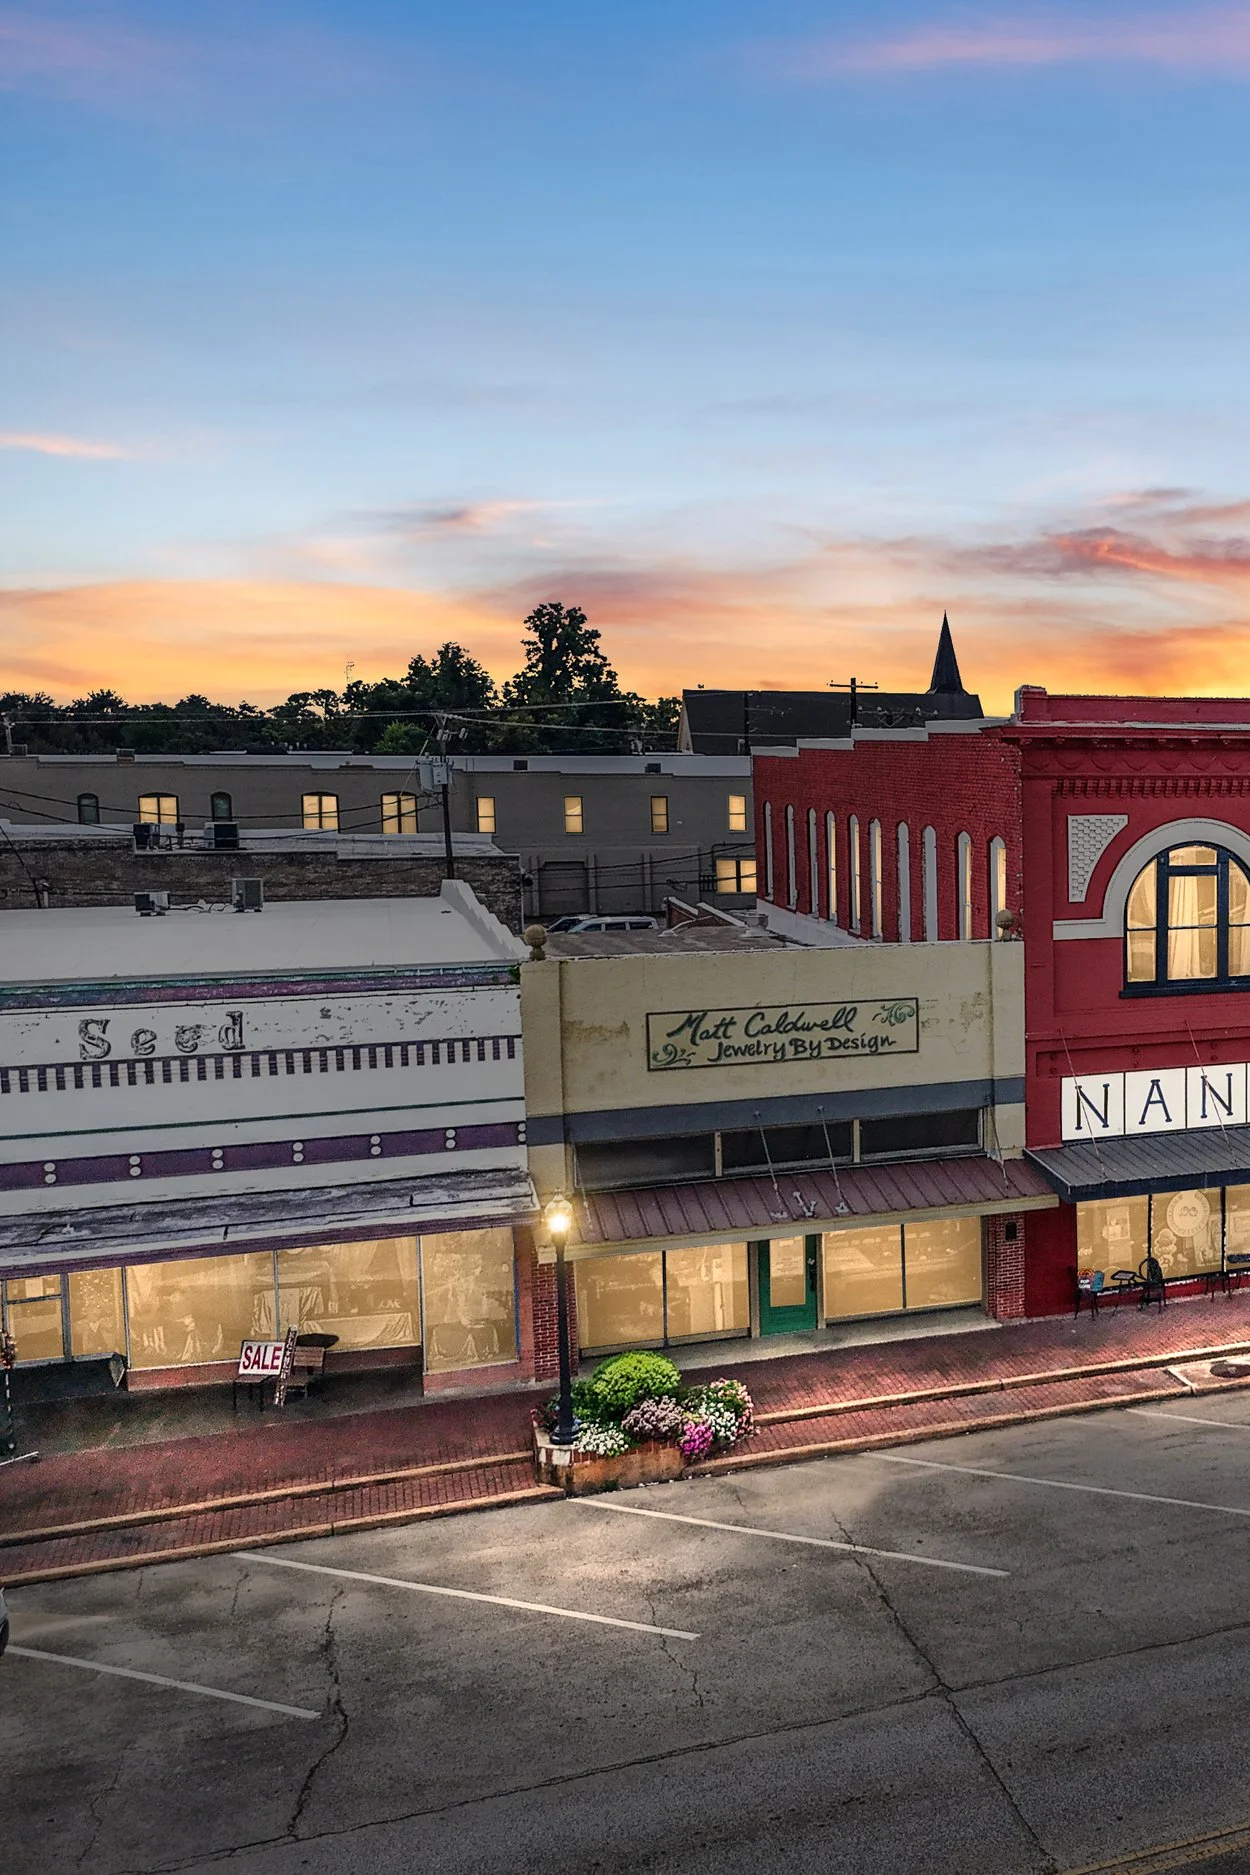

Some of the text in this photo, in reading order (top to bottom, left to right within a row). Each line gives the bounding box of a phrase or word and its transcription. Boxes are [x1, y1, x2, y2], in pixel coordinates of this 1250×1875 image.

[666, 1006, 860, 1046] Matt Caldwell
[708, 1033, 896, 1062] Jewelry By Design
[242, 1344, 282, 1370] SALE
